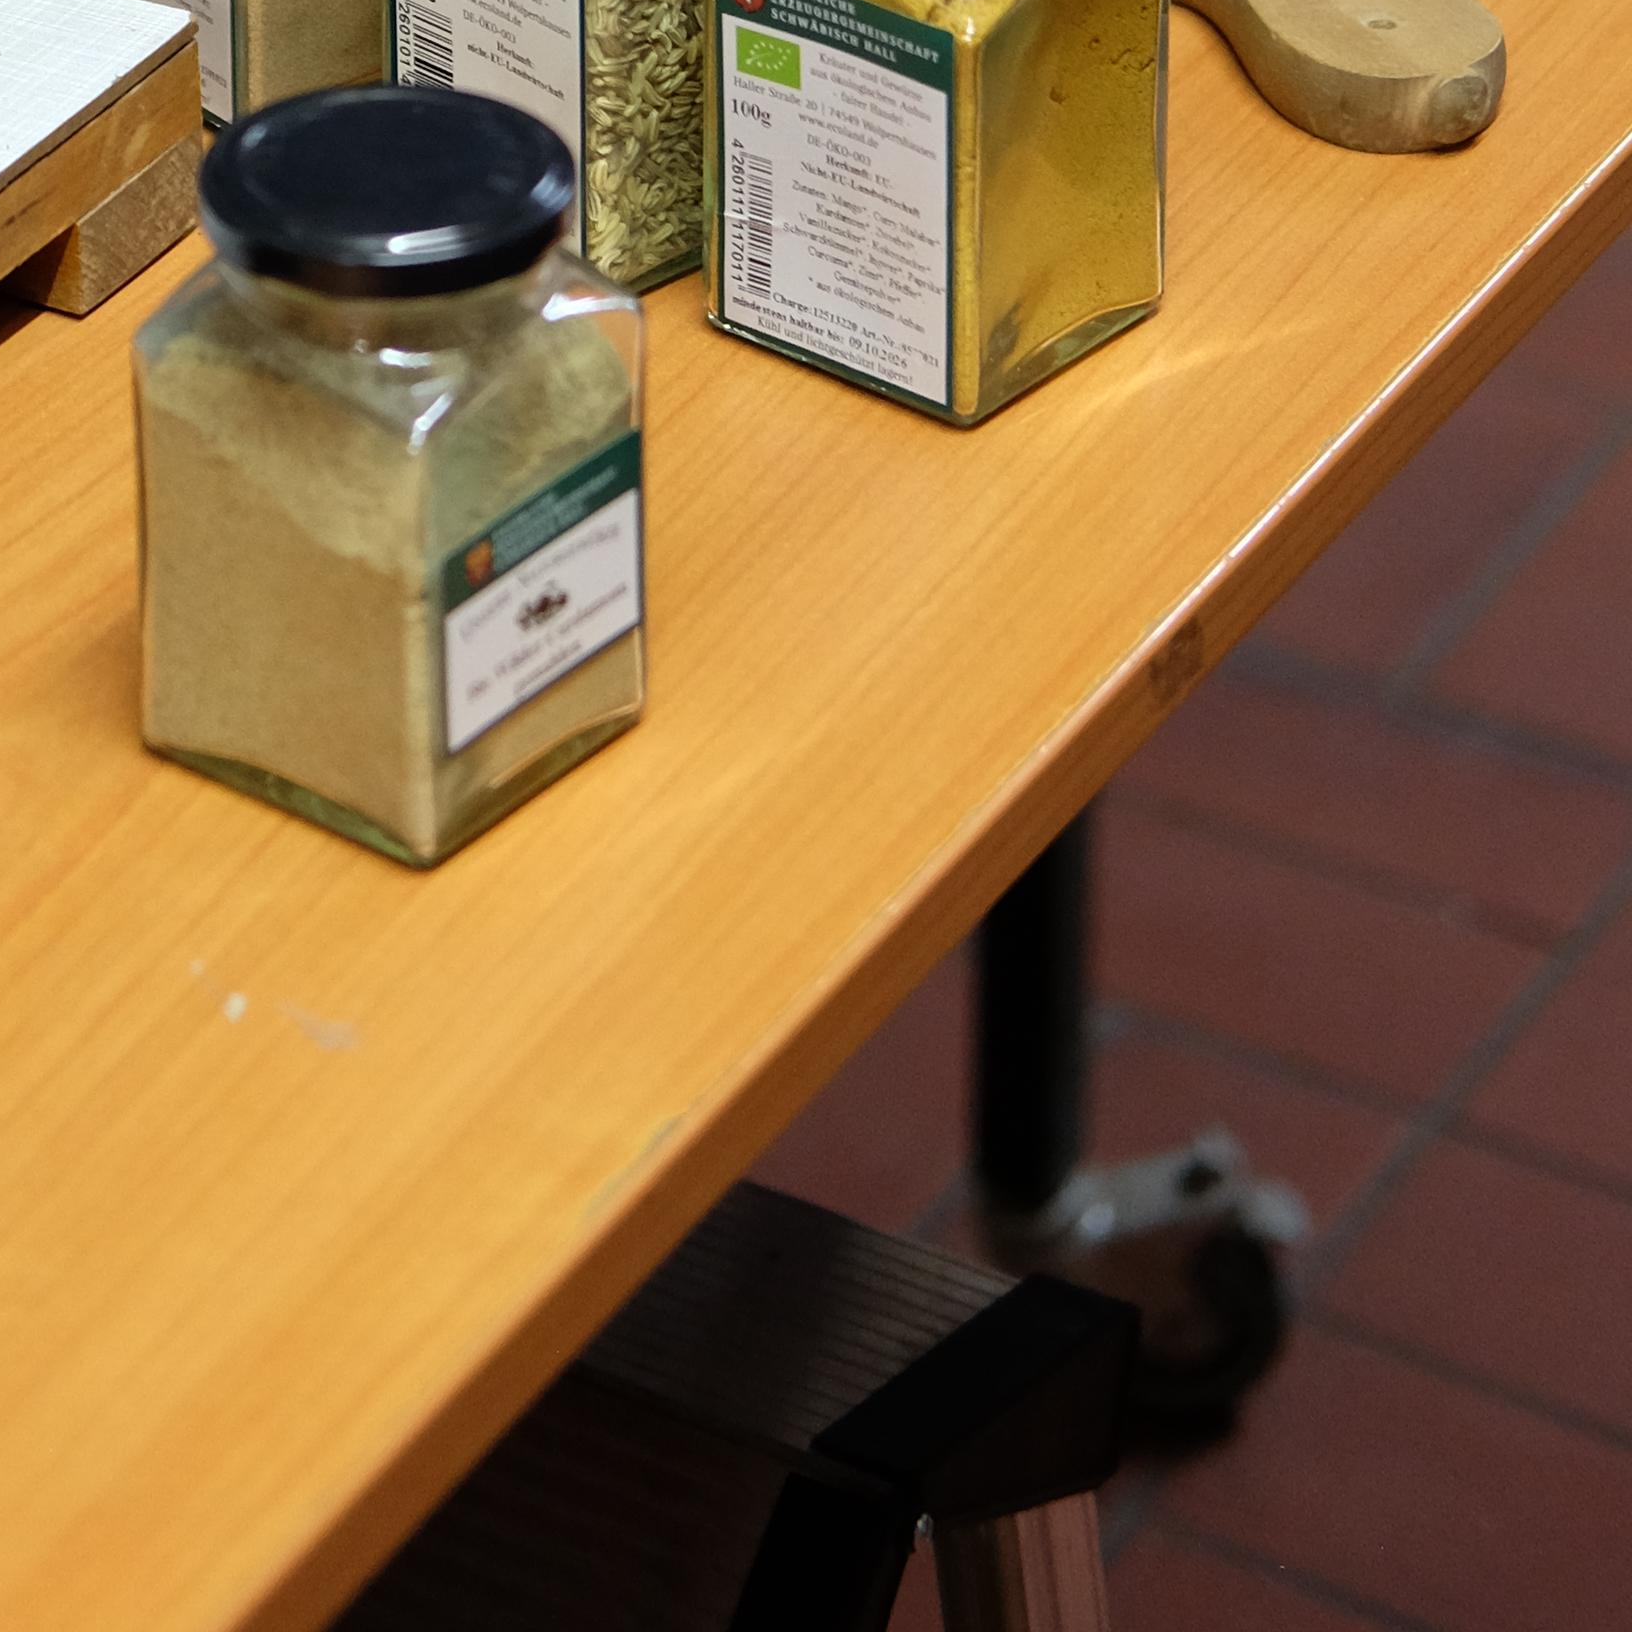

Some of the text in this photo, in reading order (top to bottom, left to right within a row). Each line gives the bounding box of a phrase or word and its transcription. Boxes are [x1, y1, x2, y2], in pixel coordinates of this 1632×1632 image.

[398, 1, 411, 67] 260101
[770, 4, 896, 63] SCHWÄBISCH HALL
[810, 66, 827, 80] aus
[858, 66, 877, 83] und
[733, 74, 765, 97] Haller
[768, 85, 801, 107] Straße
[805, 97, 817, 112] 20
[731, 95, 772, 130] 100g
[757, 313, 781, 334] Kühl
[783, 325, 803, 343] und
[789, 313, 823, 337] haltbar
[848, 334, 907, 370] 09.10.2026
